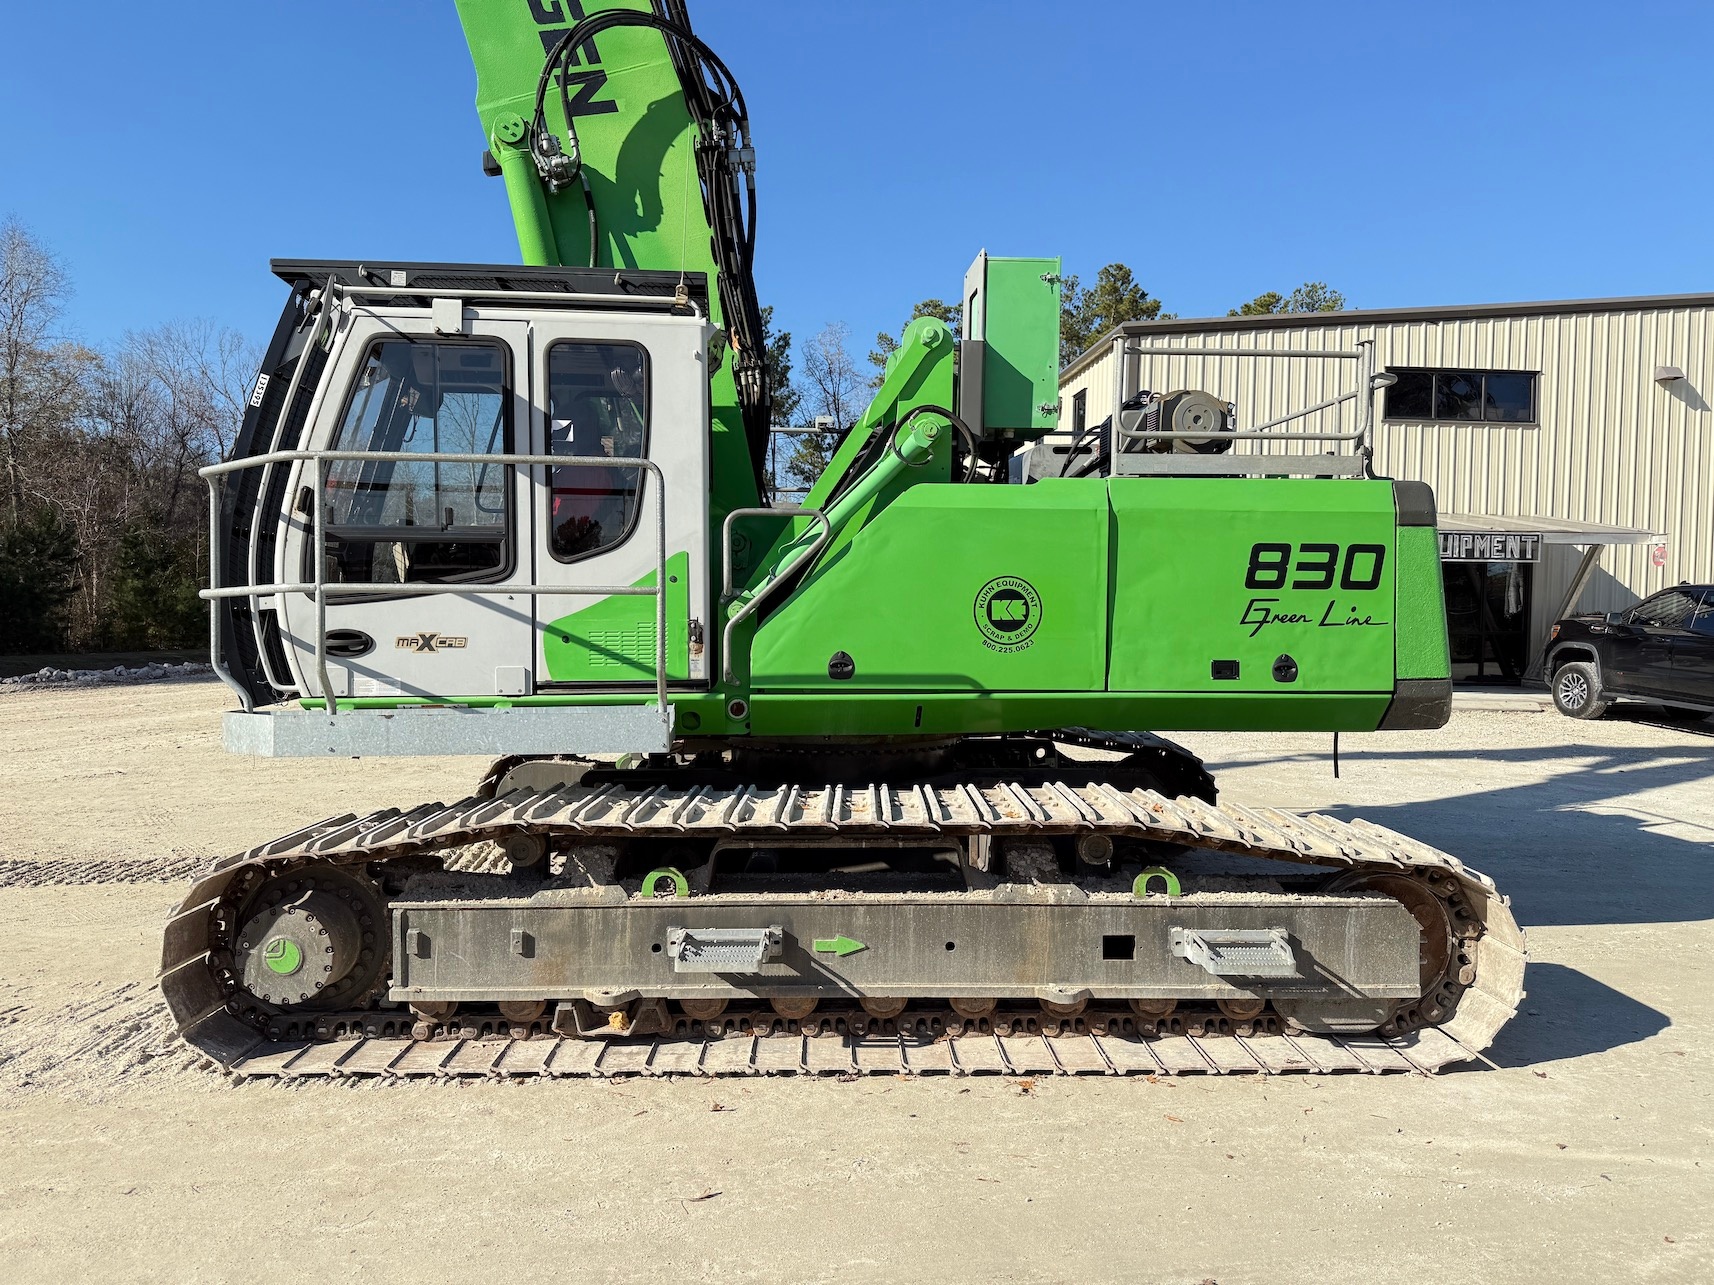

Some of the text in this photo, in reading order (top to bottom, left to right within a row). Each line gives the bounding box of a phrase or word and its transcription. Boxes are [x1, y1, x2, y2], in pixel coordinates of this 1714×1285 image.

[252, 376, 268, 405] 135395
[1244, 542, 1386, 590] 830
[979, 580, 1038, 609] KUHN EQUIPMENT
[983, 623, 1005, 641] SCRAP
[1015, 623, 1033, 640] DEMO
[1240, 598, 1389, 638] Green Line
[981, 639, 1035, 654] 800.225.0623
